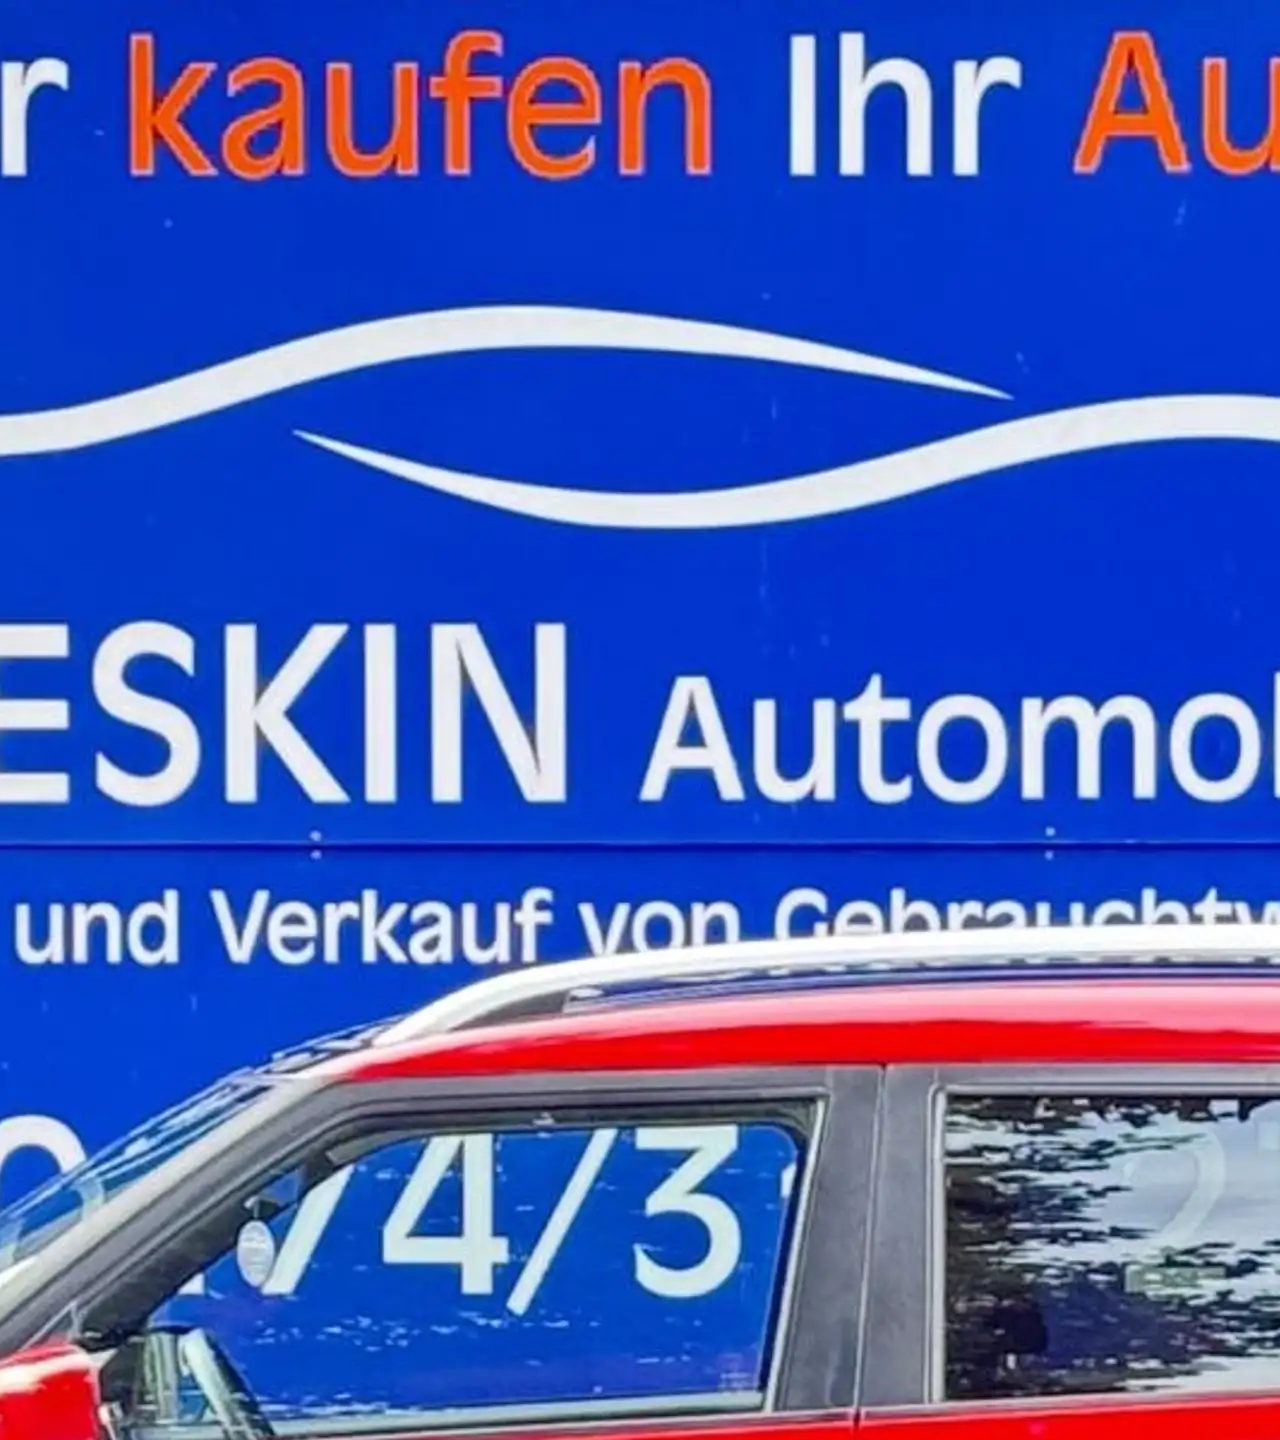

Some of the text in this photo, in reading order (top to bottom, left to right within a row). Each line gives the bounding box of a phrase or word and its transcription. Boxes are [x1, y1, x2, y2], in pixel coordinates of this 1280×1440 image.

[131, 31, 710, 178] kaufen
[791, 33, 1020, 175] Ihr
[16, 889, 179, 965] und
[211, 887, 555, 965] Verkauf
[577, 899, 741, 956] von
